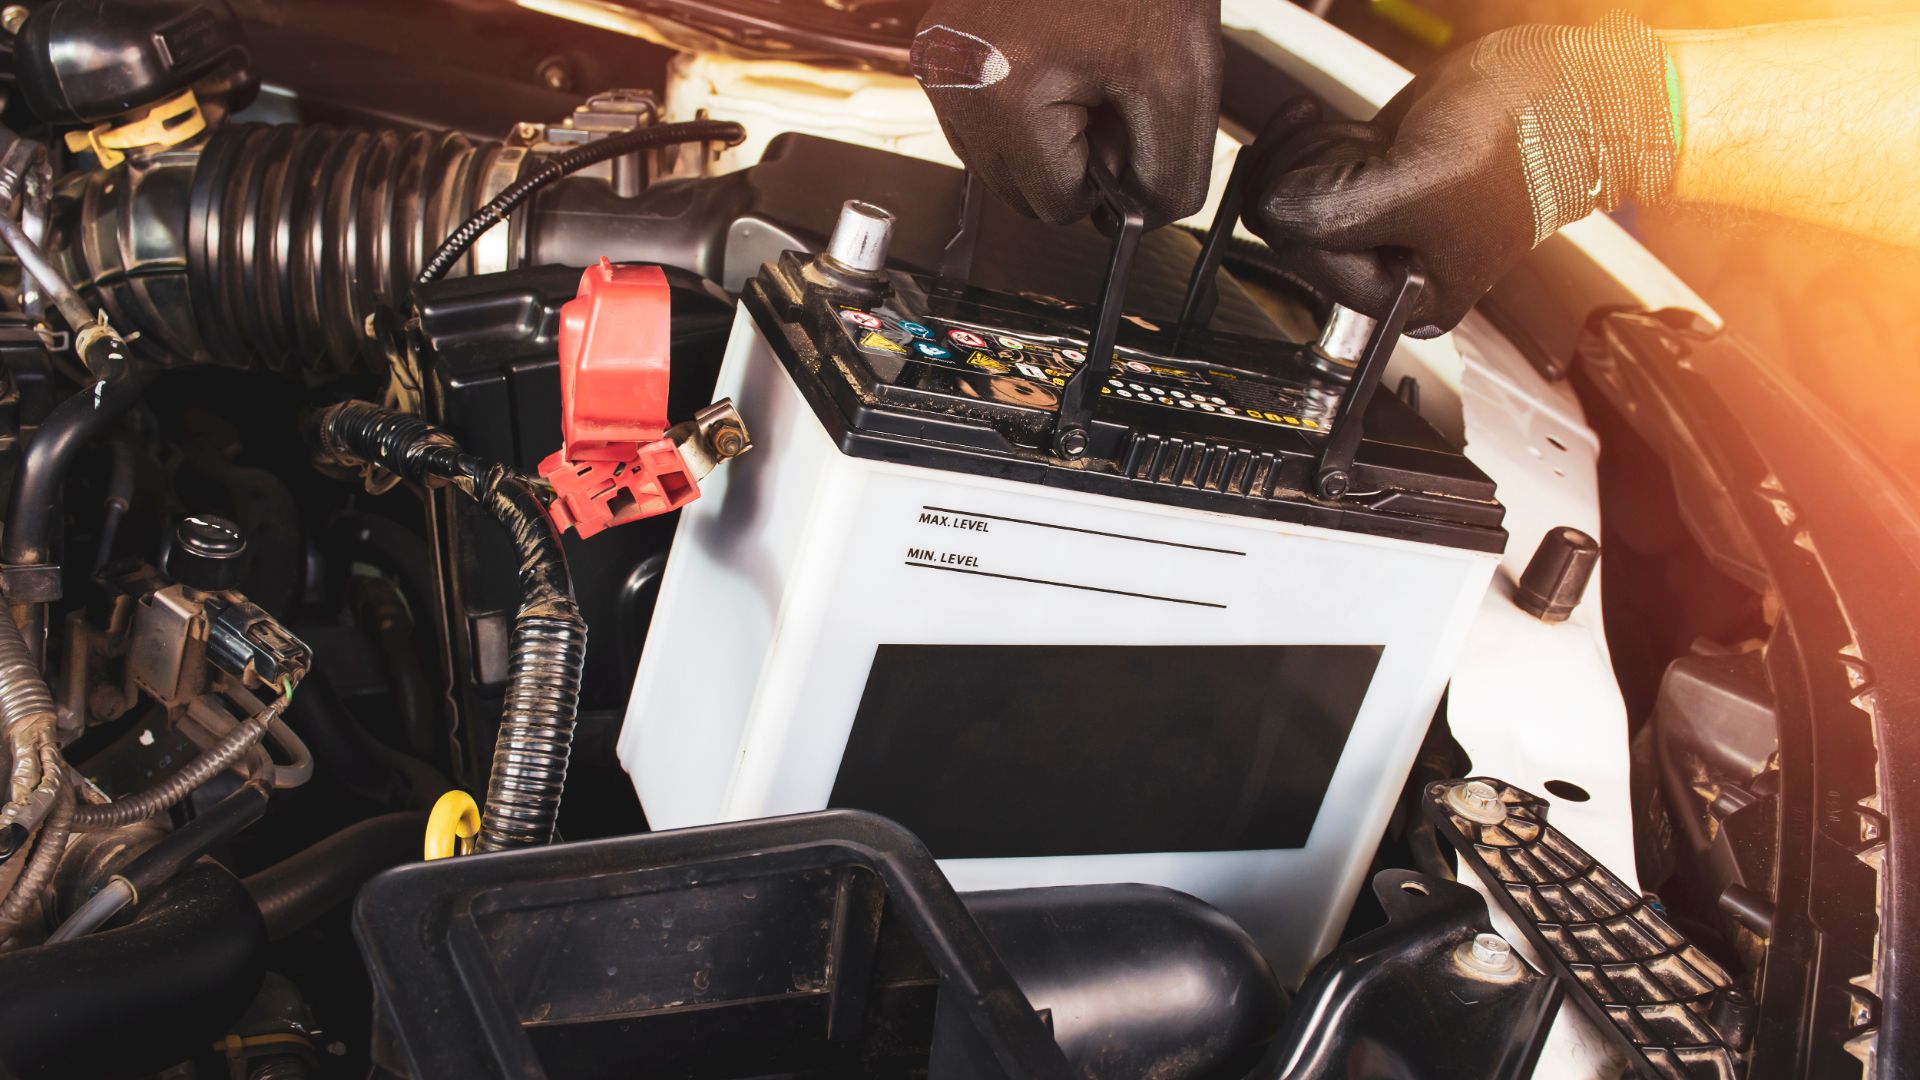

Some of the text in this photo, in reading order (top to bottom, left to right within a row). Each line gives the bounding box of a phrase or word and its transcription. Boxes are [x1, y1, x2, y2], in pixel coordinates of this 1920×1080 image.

[918, 512, 989, 533] MAX. LEVEL
[907, 547, 979, 568] MIN. LEVEL
